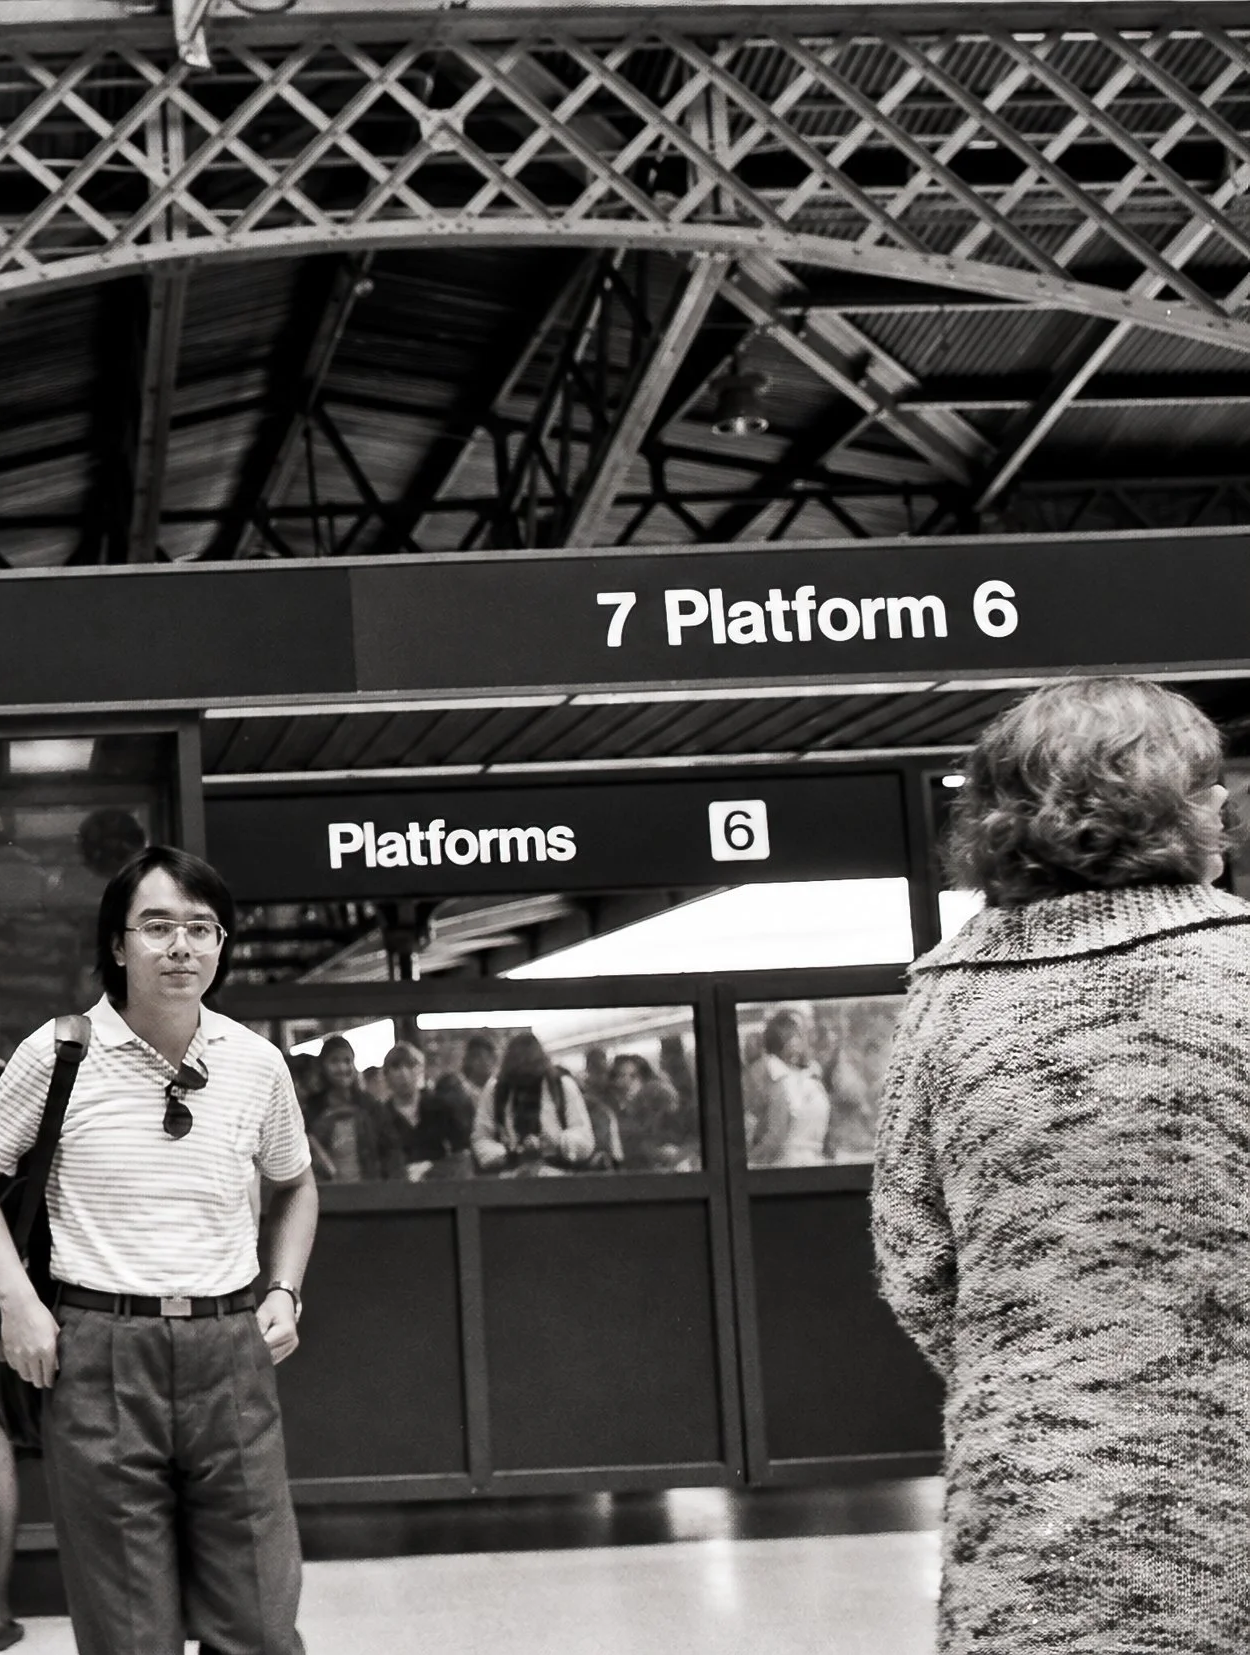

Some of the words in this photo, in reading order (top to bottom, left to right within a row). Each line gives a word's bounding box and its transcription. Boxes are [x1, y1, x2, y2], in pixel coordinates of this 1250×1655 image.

[596, 591, 637, 648] 7
[664, 585, 948, 646] Platform
[972, 579, 1019, 638] 6
[328, 819, 577, 870] Platforms
[723, 810, 755, 852] 6
